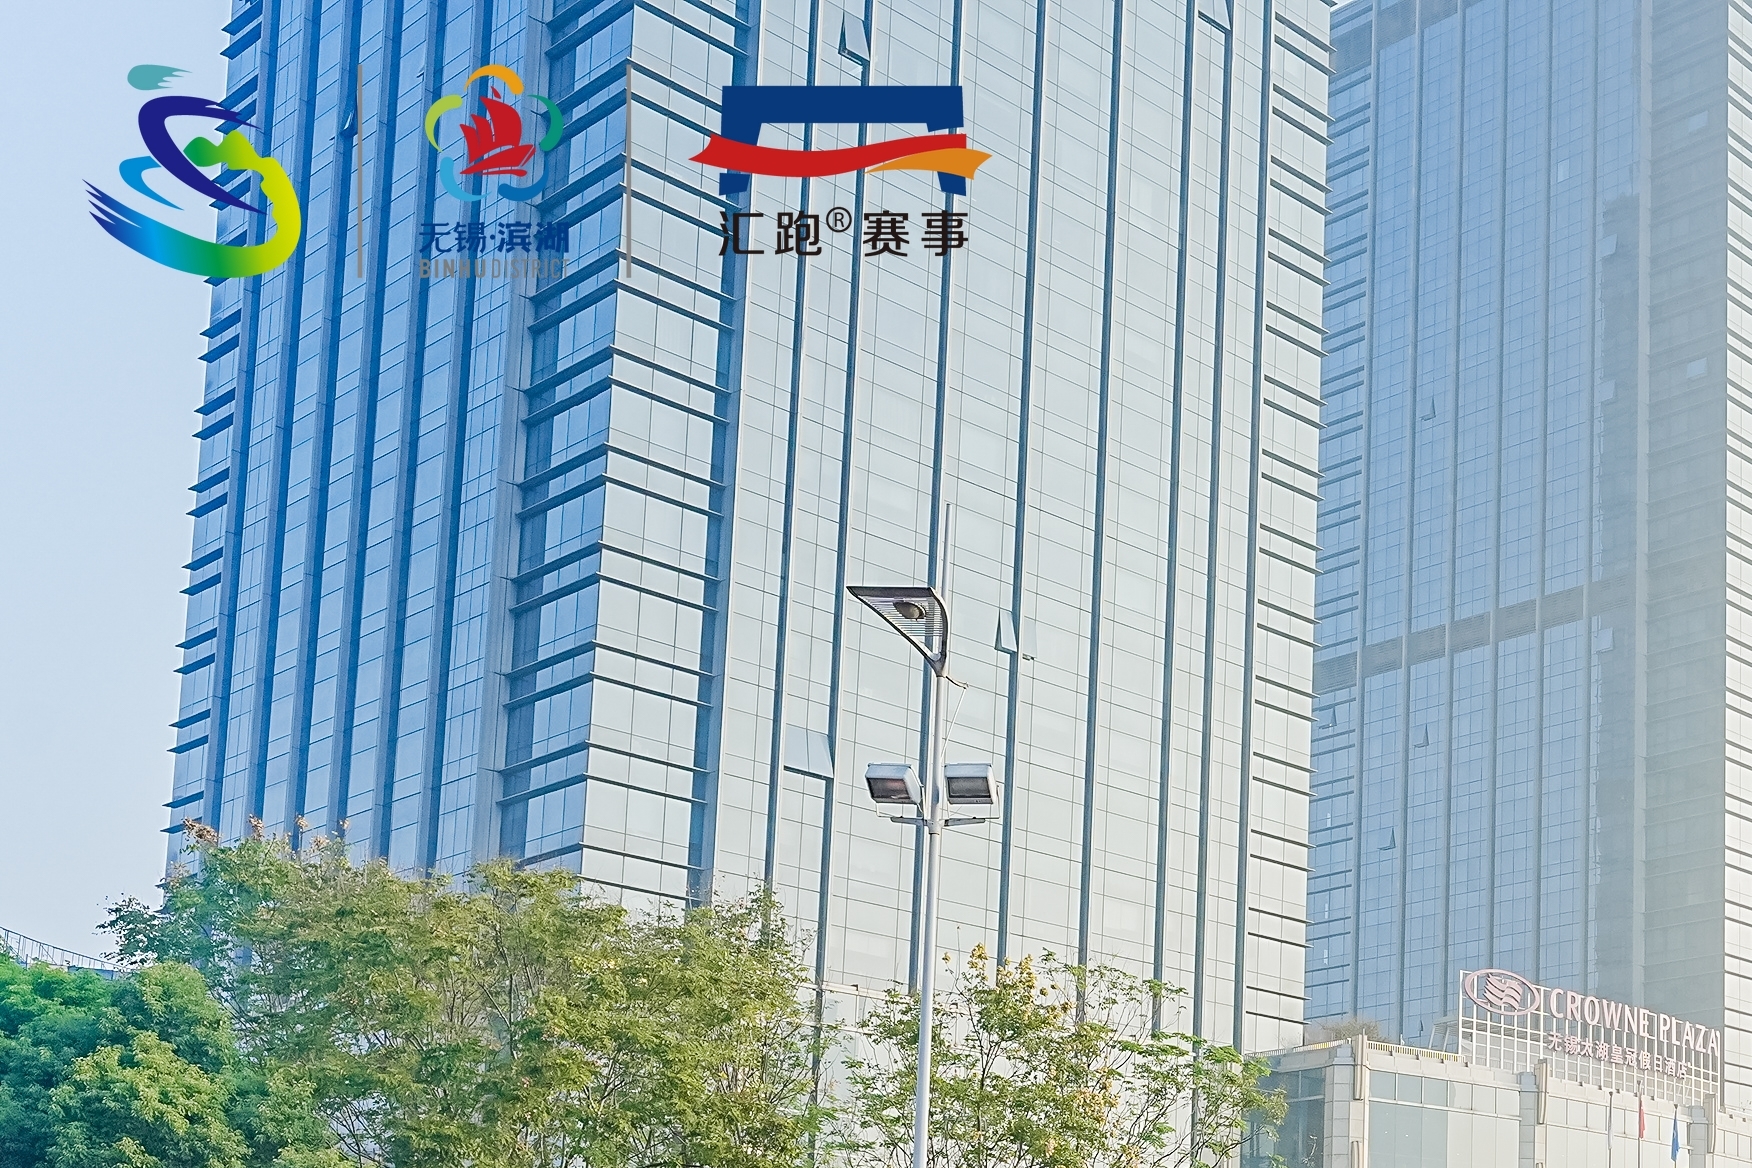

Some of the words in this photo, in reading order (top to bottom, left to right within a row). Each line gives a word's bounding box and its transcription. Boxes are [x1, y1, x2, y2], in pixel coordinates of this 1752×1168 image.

[1550, 988, 1650, 1038] CROWNE
[1659, 1014, 1720, 1057] PLAZA
[1548, 1032, 1688, 1080] 无锡太湖皇冠假日酒店
